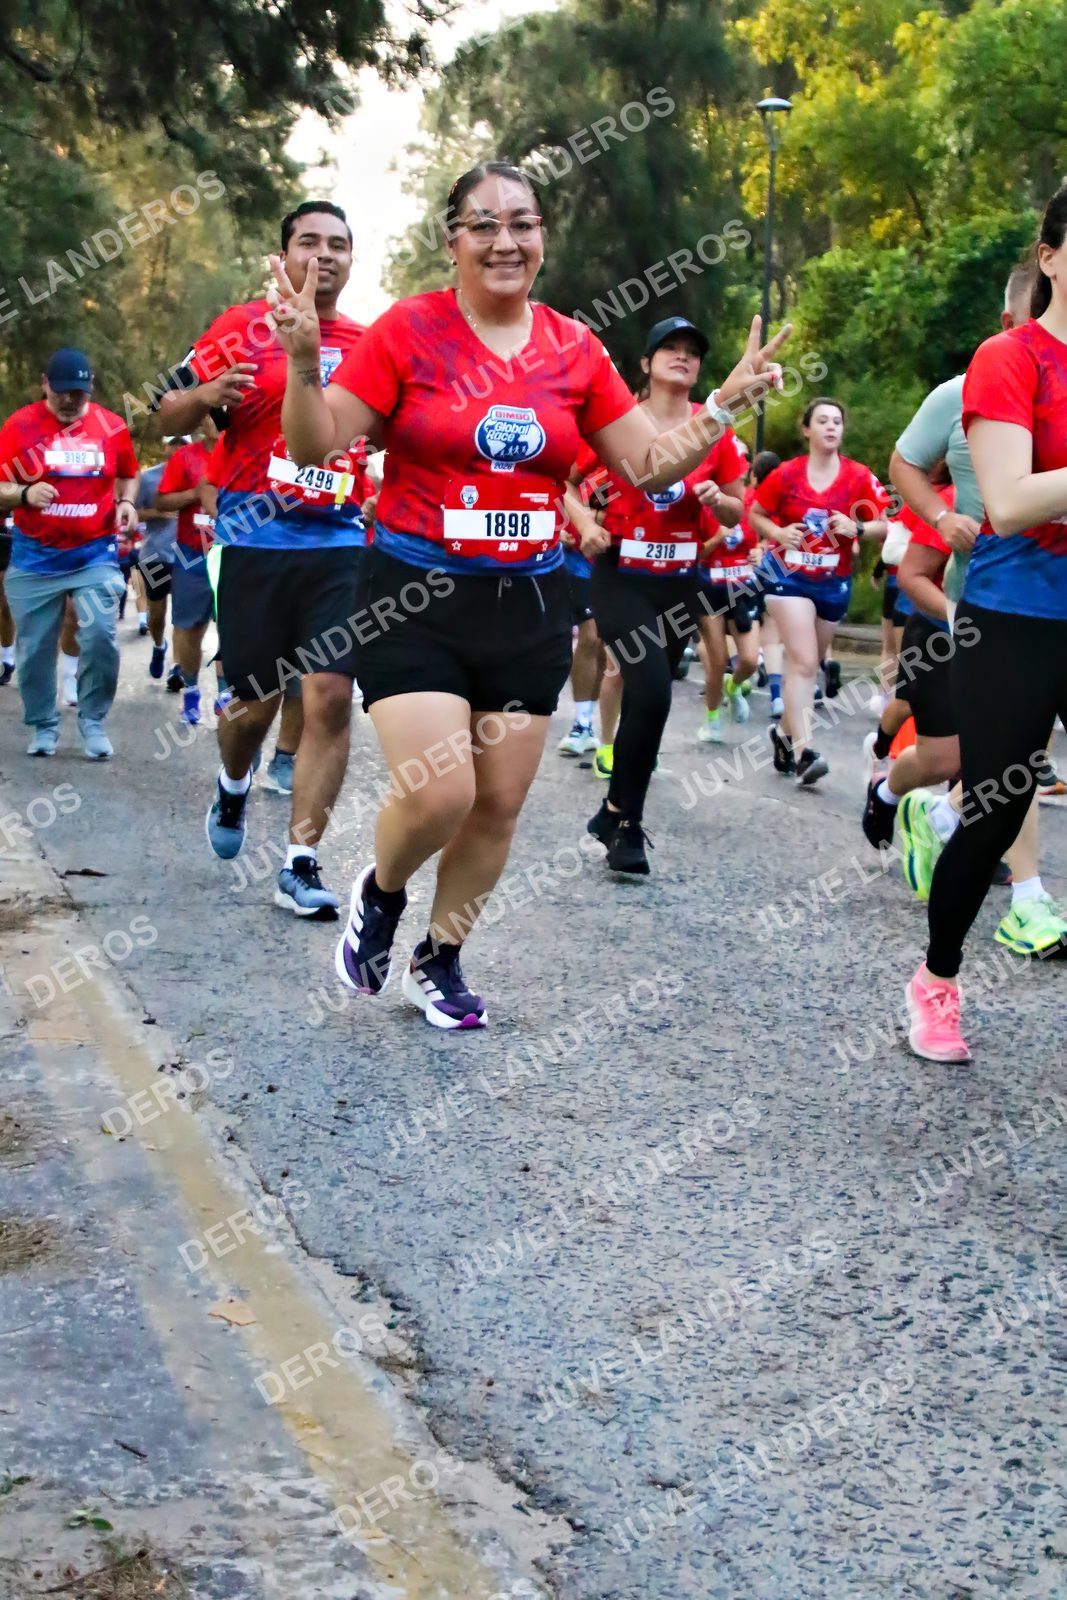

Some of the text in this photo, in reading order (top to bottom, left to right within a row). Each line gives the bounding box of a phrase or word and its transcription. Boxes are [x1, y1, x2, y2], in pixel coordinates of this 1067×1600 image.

[495, 411, 530, 420] BIMBO
[494, 421, 530, 435] Global
[486, 430, 515, 442] Race
[494, 462, 514, 470] 2026
[294, 466, 334, 490] 2498
[484, 512, 530, 537] 1898
[646, 543, 676, 559] 2318
